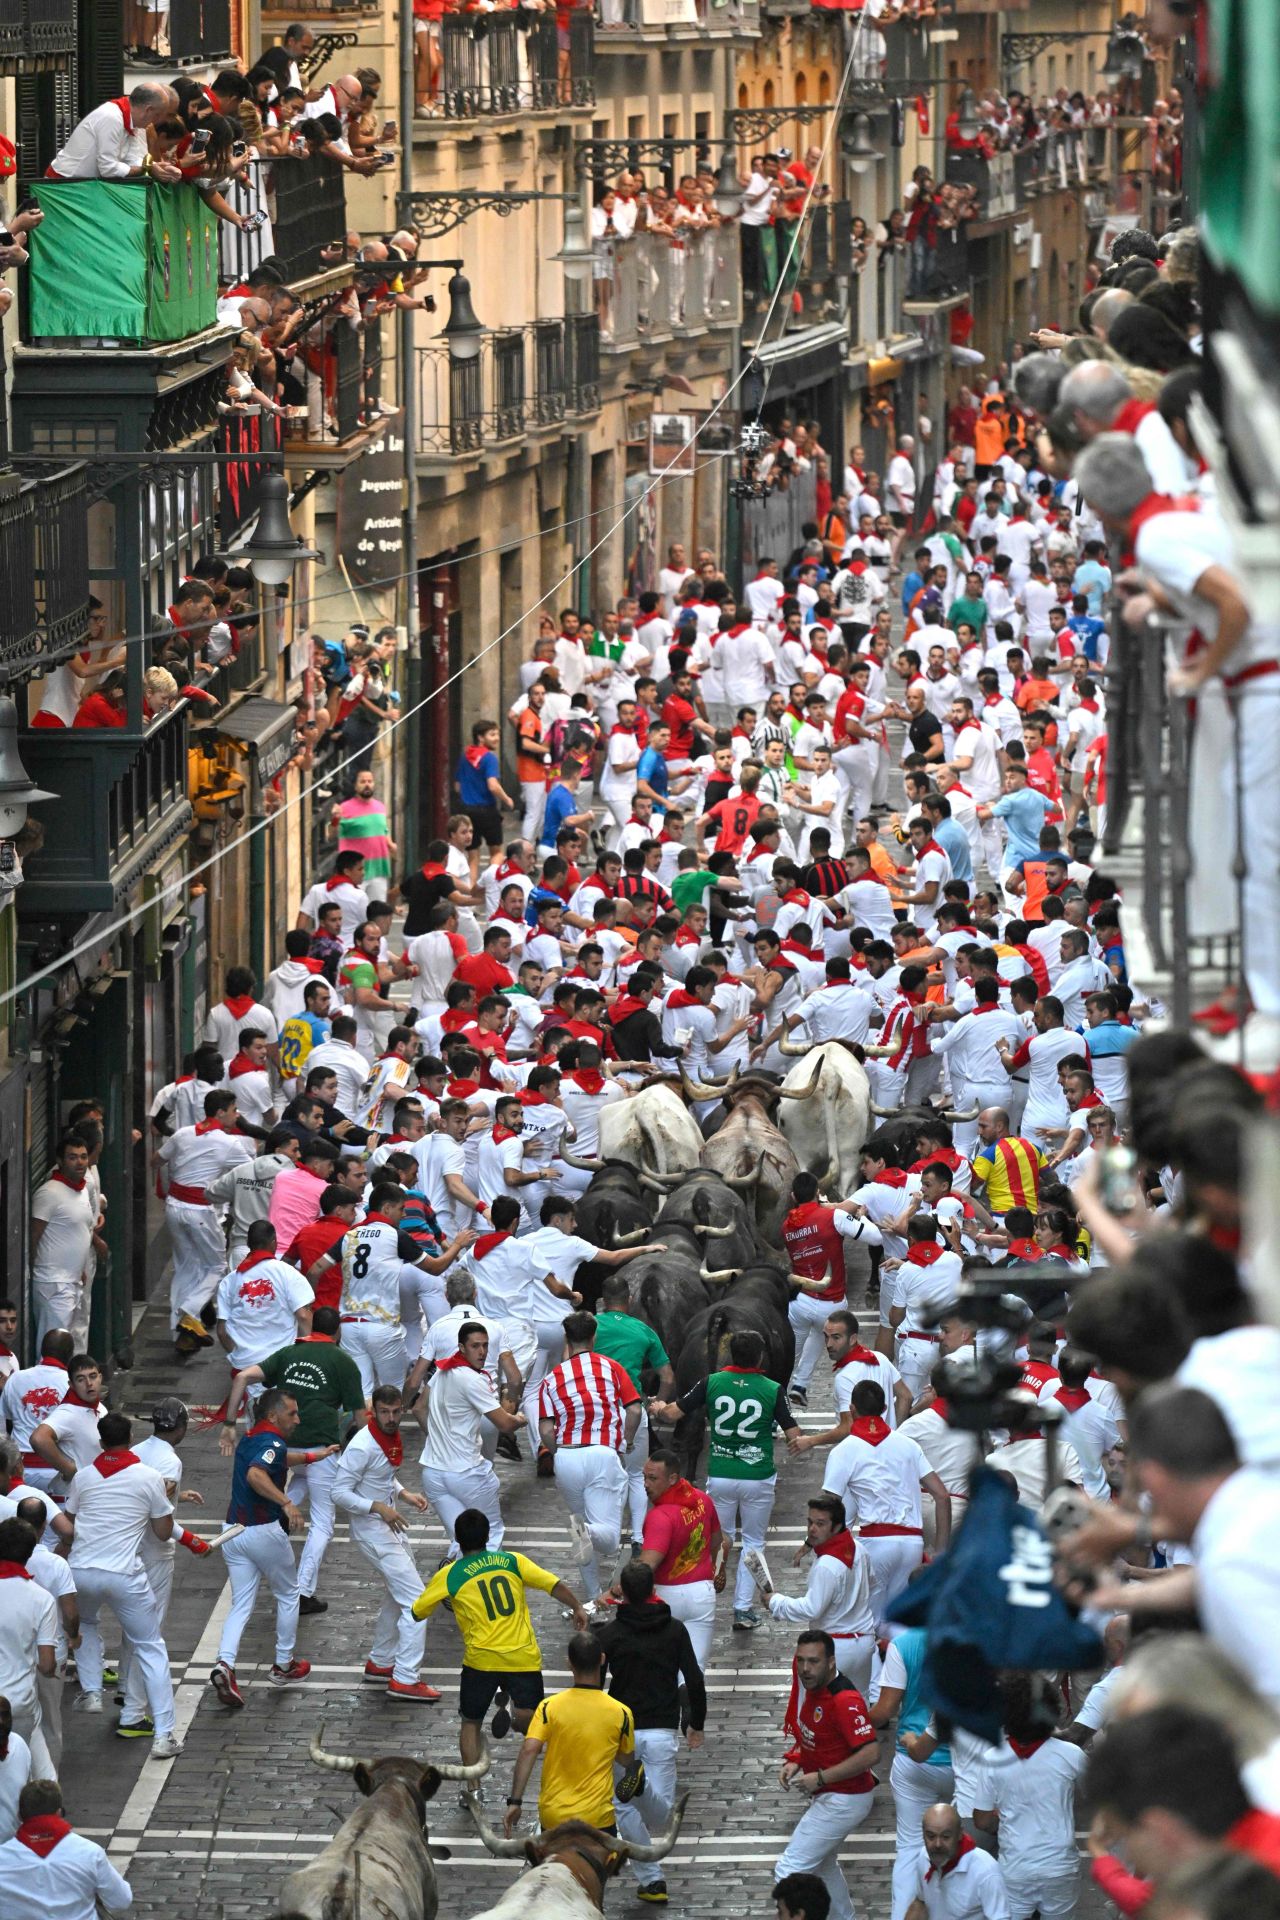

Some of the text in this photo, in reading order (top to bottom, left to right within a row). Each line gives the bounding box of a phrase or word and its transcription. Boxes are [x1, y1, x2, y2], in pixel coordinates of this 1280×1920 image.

[357, 538, 375, 551] de
[734, 808, 748, 836] 8
[236, 1177, 274, 1190] ESSENTIALS
[354, 1228, 381, 1238] IÑIGO
[785, 1226, 813, 1241] EZKURRA
[353, 1243, 372, 1279] 8
[714, 1395, 763, 1439] 22
[463, 1554, 510, 1577] RONALDINHO
[476, 1575, 515, 1622] 10
